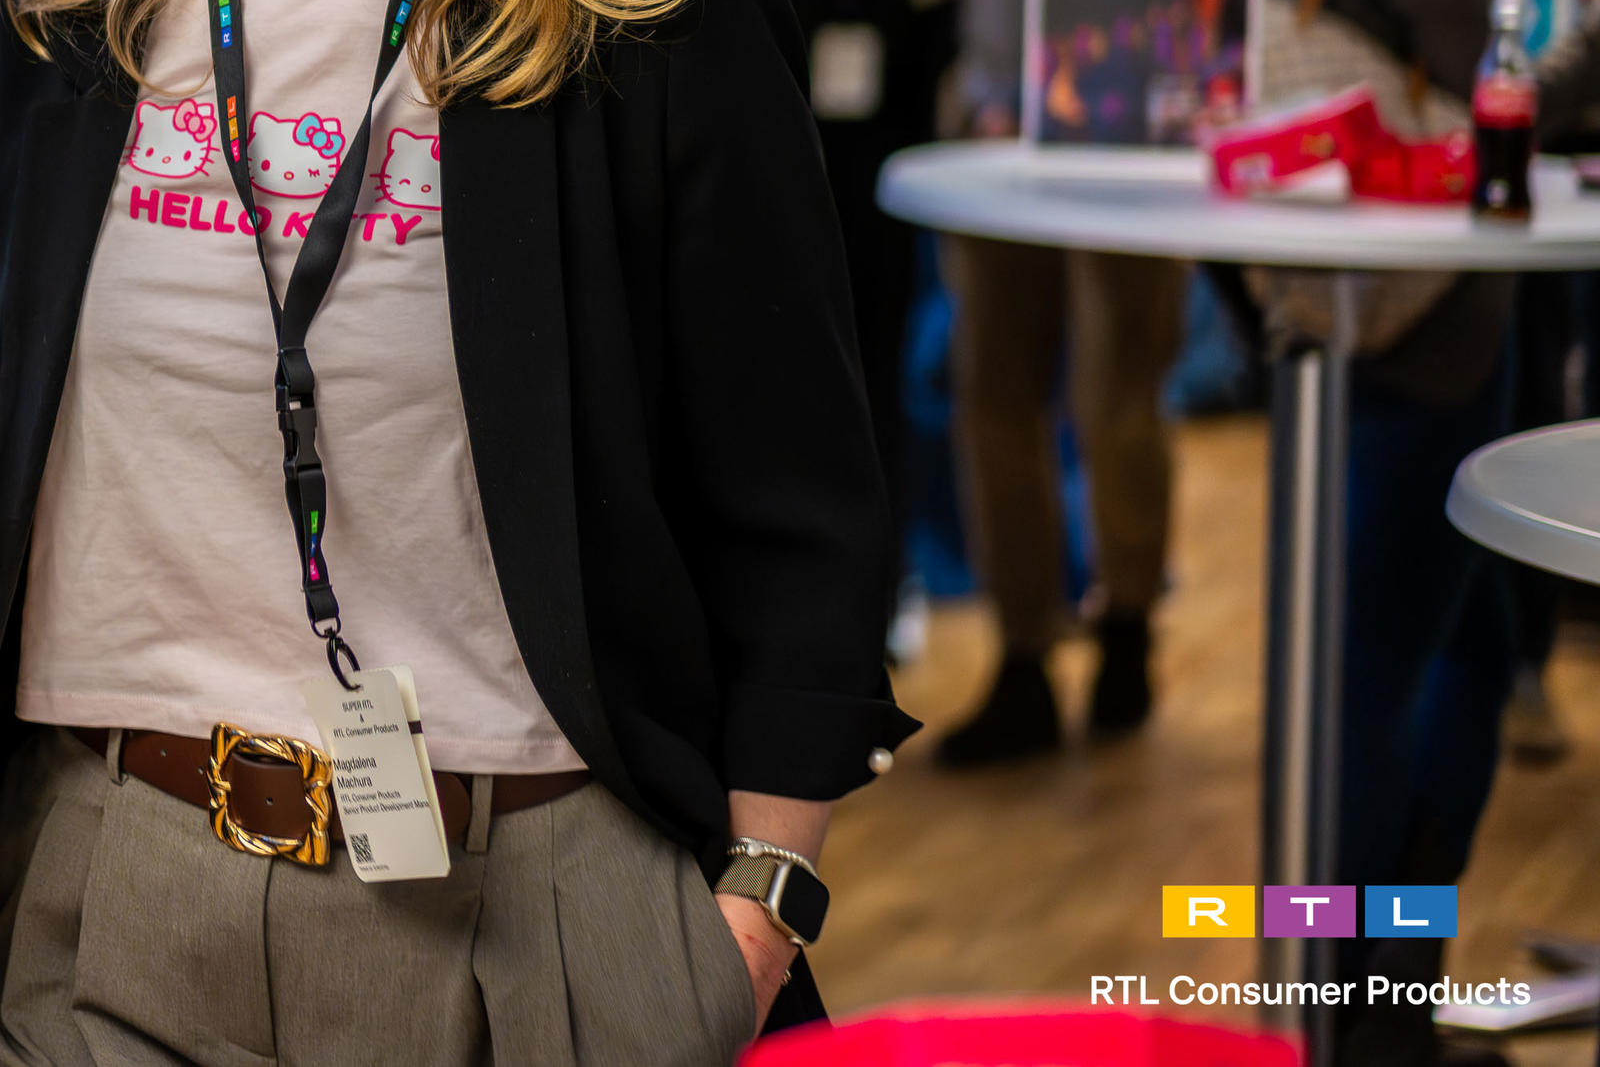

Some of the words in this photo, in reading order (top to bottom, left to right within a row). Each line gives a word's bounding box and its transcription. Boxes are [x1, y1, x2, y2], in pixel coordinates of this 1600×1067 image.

[129, 185, 272, 236] HELLO
[282, 211, 422, 245] KTY
[333, 728, 345, 738] RTL
[345, 727, 373, 737] Consumer
[373, 724, 399, 733] Products
[332, 756, 377, 773] Magdalena
[336, 775, 373, 789] Machura
[352, 793, 377, 803] Consumer
[377, 790, 401, 800] Products
[360, 802, 380, 813] Product
[380, 800, 414, 812] Development
